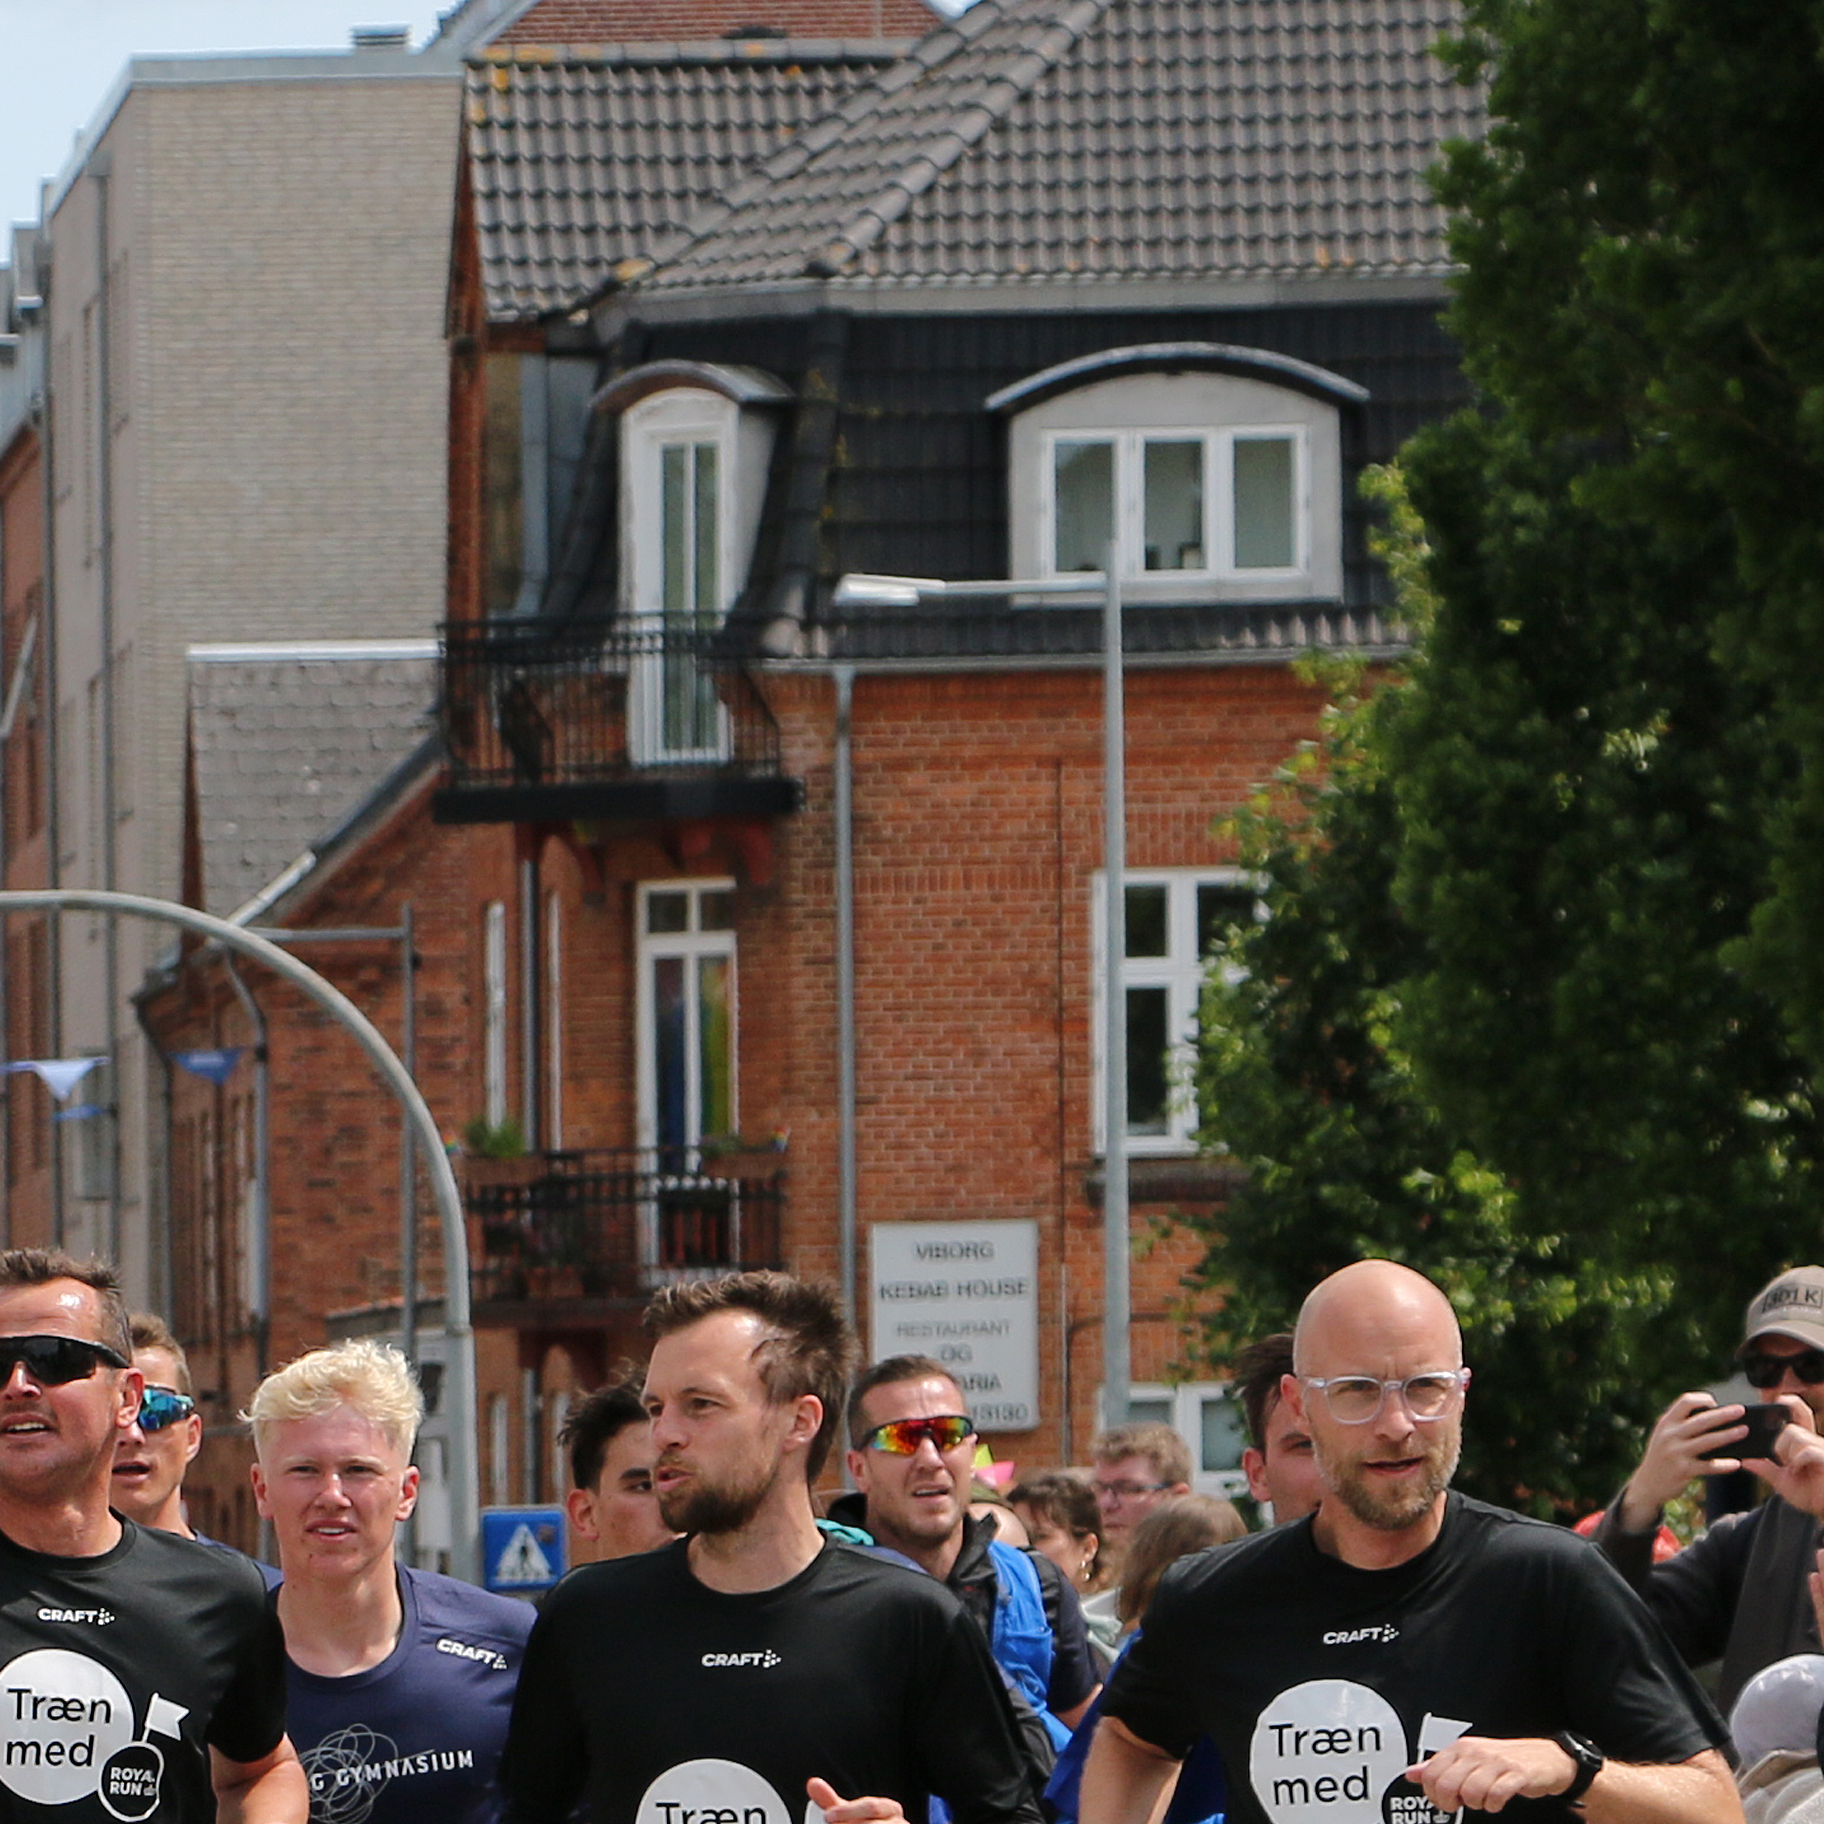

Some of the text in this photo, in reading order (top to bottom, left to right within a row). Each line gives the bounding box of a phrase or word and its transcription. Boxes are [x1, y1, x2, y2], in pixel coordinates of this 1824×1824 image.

[915, 1241, 995, 1260] VIBORG
[880, 1278, 1029, 1299] KEBAB HOUSE
[897, 1319, 1010, 1337] RESTAURANT
[38, 1607, 99, 1624] CRAFT
[1323, 1627, 1383, 1645] CRAFT
[436, 1638, 496, 1664] CRAFT
[701, 1652, 763, 1667] CRAFT
[7, 1688, 112, 1724] Træn
[1269, 1722, 1382, 1757] Træn
[6, 1734, 95, 1767] med
[336, 1750, 474, 1787] GYMNASIUM
[109, 1782, 142, 1796] RUN
[1273, 1765, 1370, 1805] med
